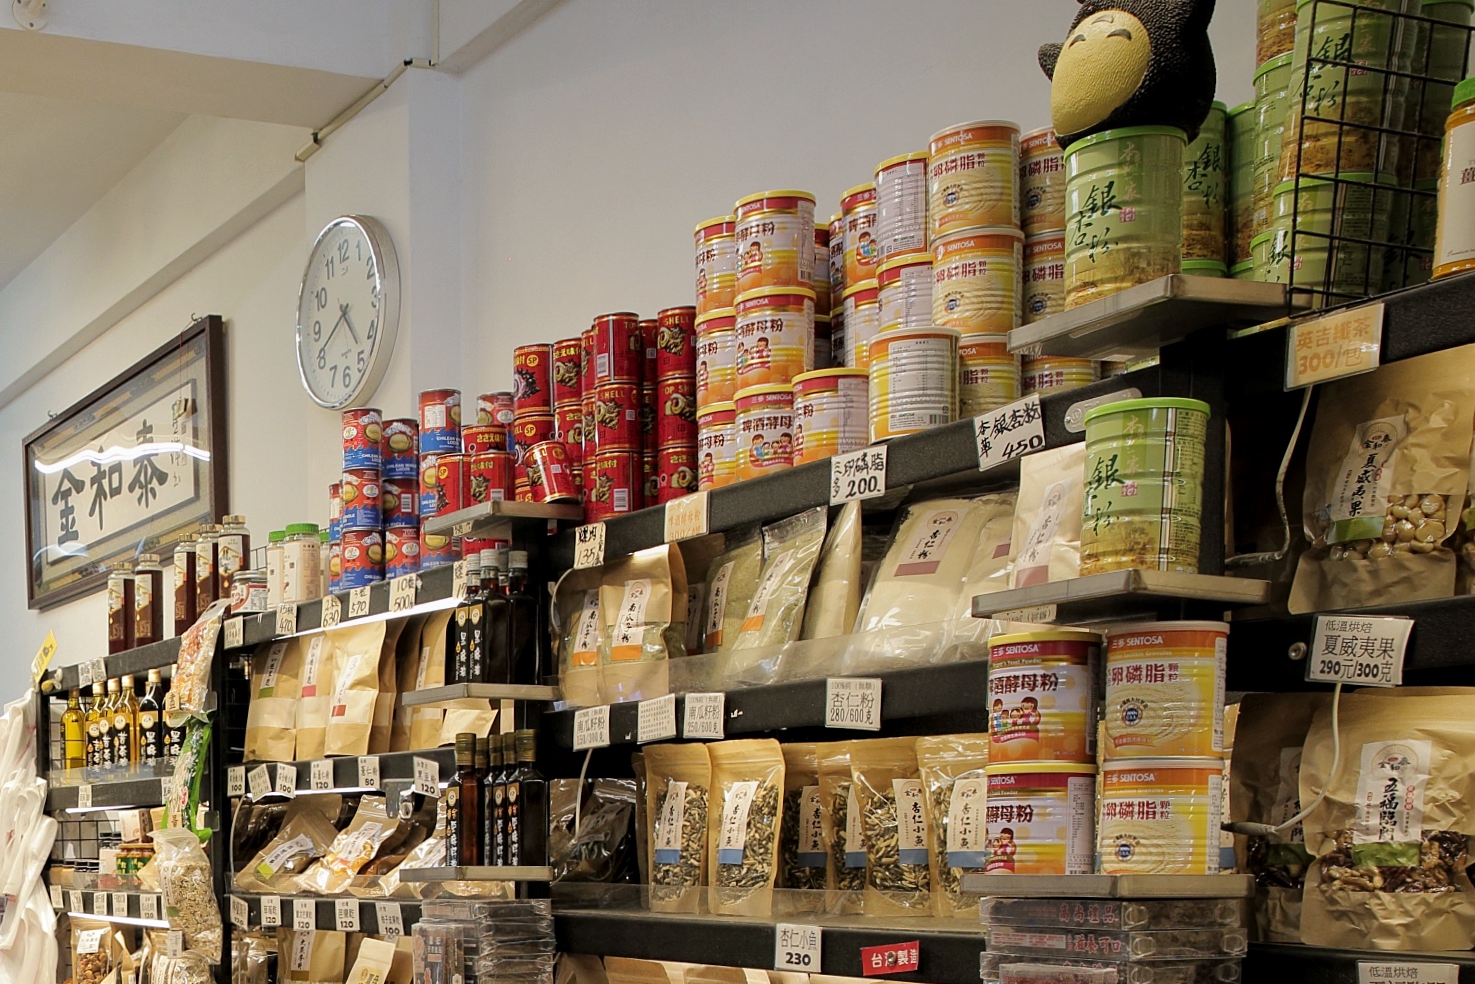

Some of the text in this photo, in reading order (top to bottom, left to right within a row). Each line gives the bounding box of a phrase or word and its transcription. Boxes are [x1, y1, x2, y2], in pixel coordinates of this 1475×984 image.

[943, 131, 974, 145] SENTOSA
[1067, 180, 1124, 264] 銀杏粉
[337, 238, 350, 265] 12
[356, 240, 361, 261] 1
[946, 239, 976, 252] SENTOSA
[325, 256, 334, 280] 11
[366, 255, 375, 280] 2
[315, 287, 328, 311] 10
[663, 316, 691, 325] SHELL
[313, 320, 322, 343] 9
[367, 319, 375, 340] 4
[316, 347, 327, 370] 8
[356, 350, 365, 373] 5
[527, 356, 538, 365] SP
[329, 364, 339, 388] 7
[342, 365, 352, 388] 6
[599, 390, 626, 401] SHELL
[1001, 434, 1046, 460] 450
[1324, 619, 1374, 633] 低溫烘焙
[1005, 644, 1040, 656] SENTOSA
[1111, 636, 1164, 649] 三多 SENTOSA
[1322, 635, 1395, 660] 夏威夷果
[1111, 663, 1166, 685] 卵磷脂
[1319, 659, 1393, 683] 290元/300克
[830, 692, 875, 709] 杏仁粉
[688, 705, 721, 721] 南瓜籽粉
[830, 709, 875, 725] 280/600克
[315, 781, 329, 790] 120
[990, 775, 1016, 785] SENTOSA
[1120, 773, 1156, 783] SENTOSA
[420, 783, 436, 794] 120
[1105, 801, 1157, 821] 卵磷脂
[911, 801, 925, 848] 杏仁小魚
[265, 916, 277, 924] 120
[339, 920, 354, 929] 120
[384, 926, 400, 935] 100
[780, 928, 818, 951] 杏仁小魚
[785, 952, 812, 967] 230
[1368, 965, 1419, 980] 低溫烘焙
